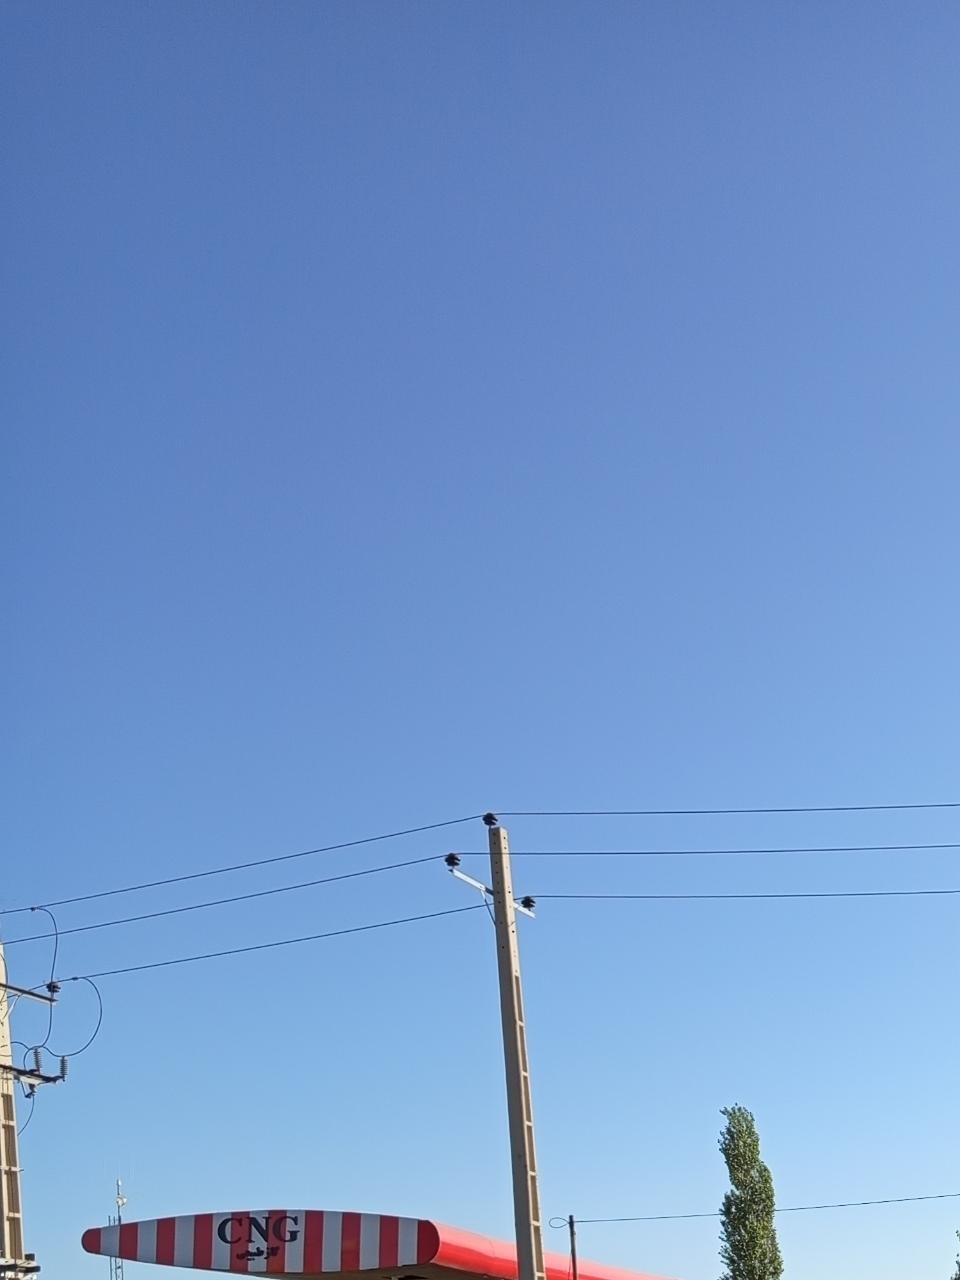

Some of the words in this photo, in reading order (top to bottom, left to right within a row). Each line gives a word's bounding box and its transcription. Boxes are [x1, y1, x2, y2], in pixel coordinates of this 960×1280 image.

[217, 1215, 300, 1245] CNG
[236, 1246, 264, 1261] طبیعی
[264, 1246, 280, 1260] گاز
